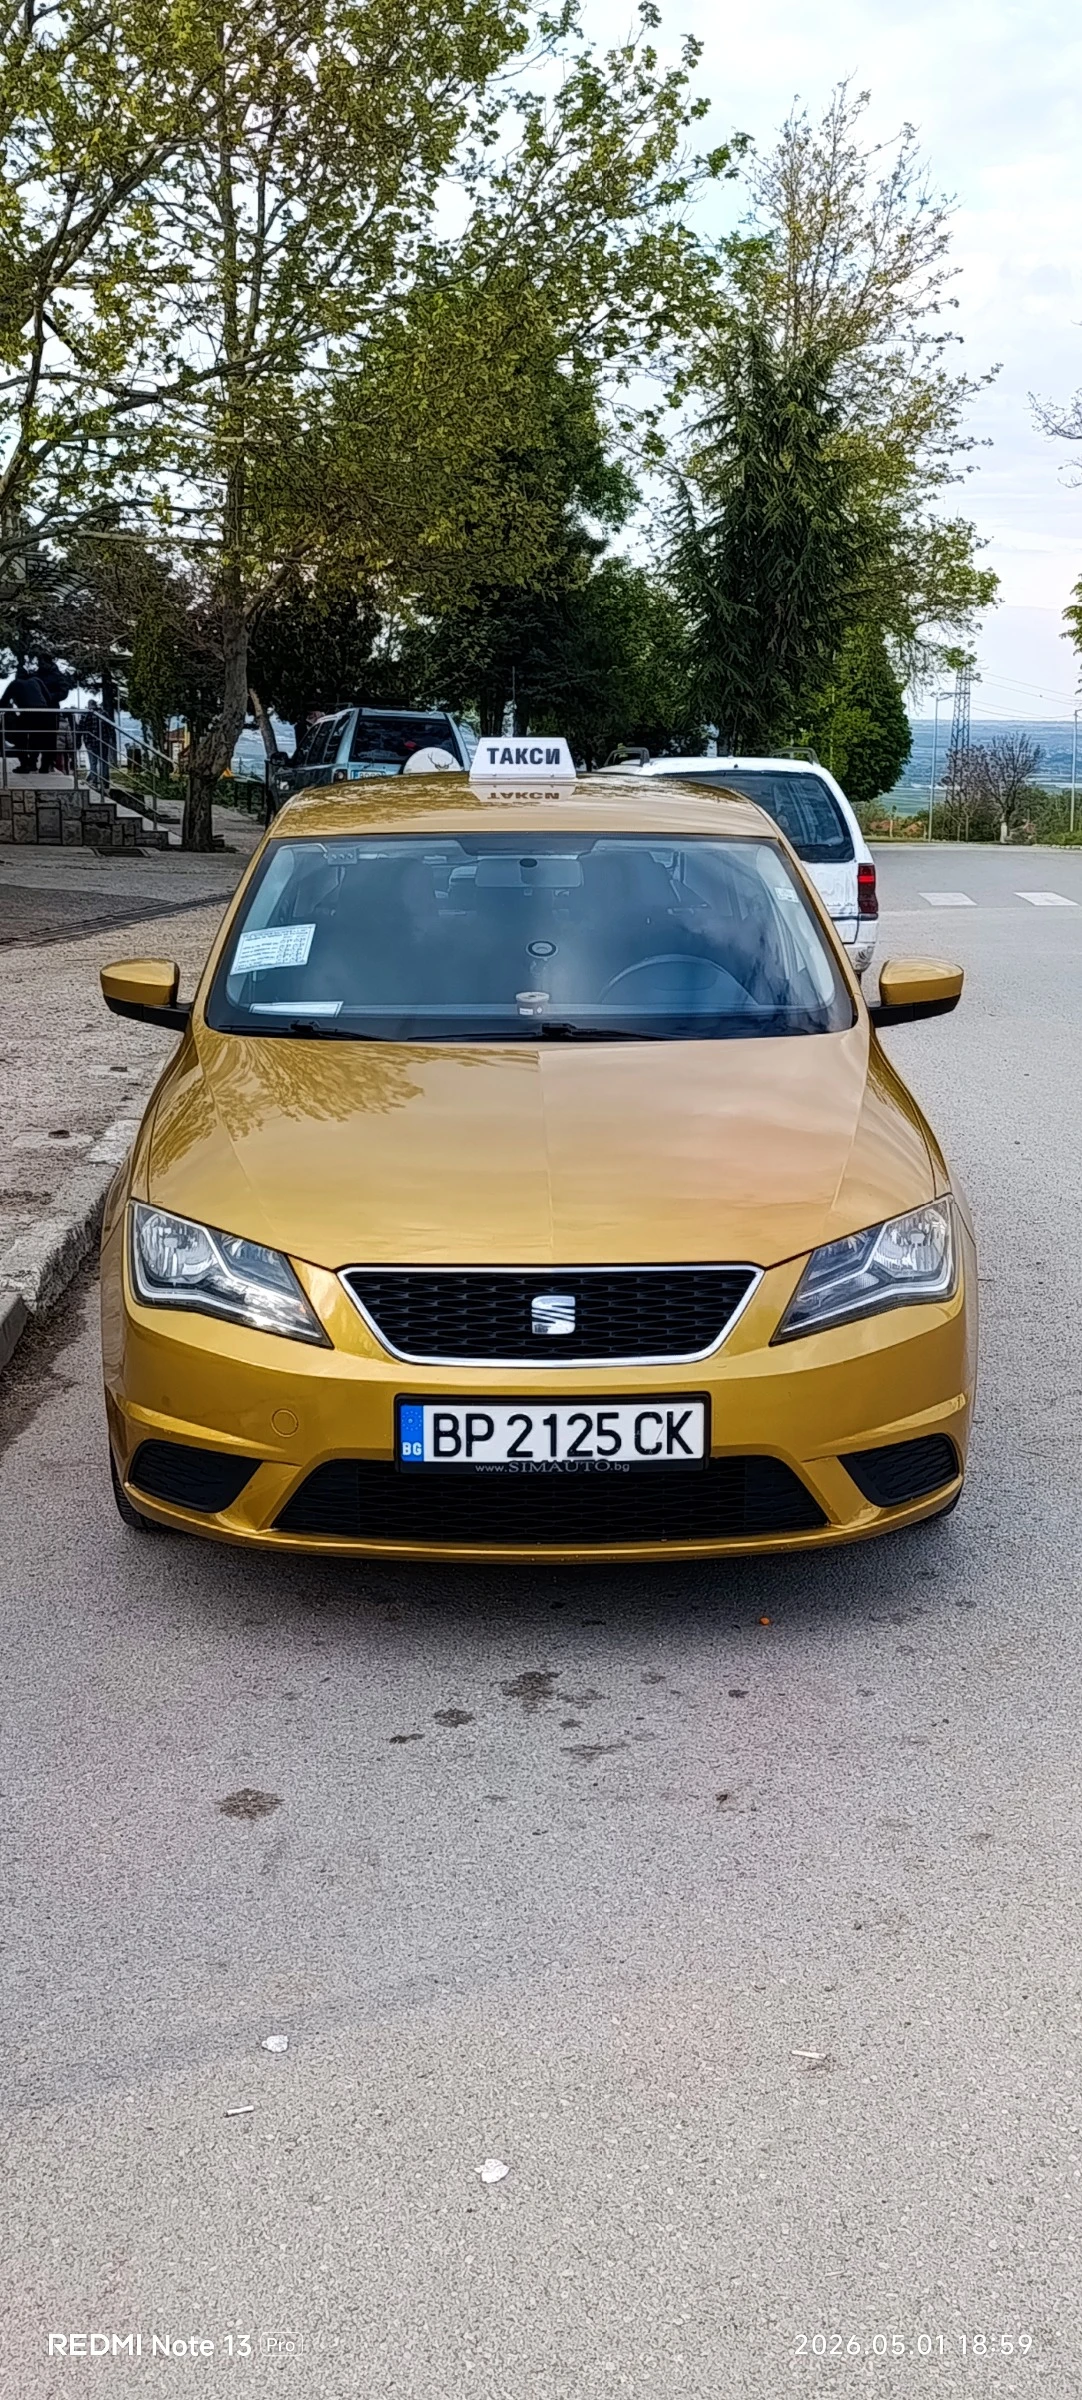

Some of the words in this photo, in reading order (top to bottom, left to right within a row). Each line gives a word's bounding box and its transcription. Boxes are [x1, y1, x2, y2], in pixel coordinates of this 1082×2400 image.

[486, 747, 560, 765] ТАКСИ
[433, 1412, 495, 1458] BP
[506, 1411, 622, 1458] 2125
[634, 1410, 695, 1456] CK
[402, 1441, 422, 1456] BG
[475, 1459, 630, 1473] www.SIMAUTO.bg
